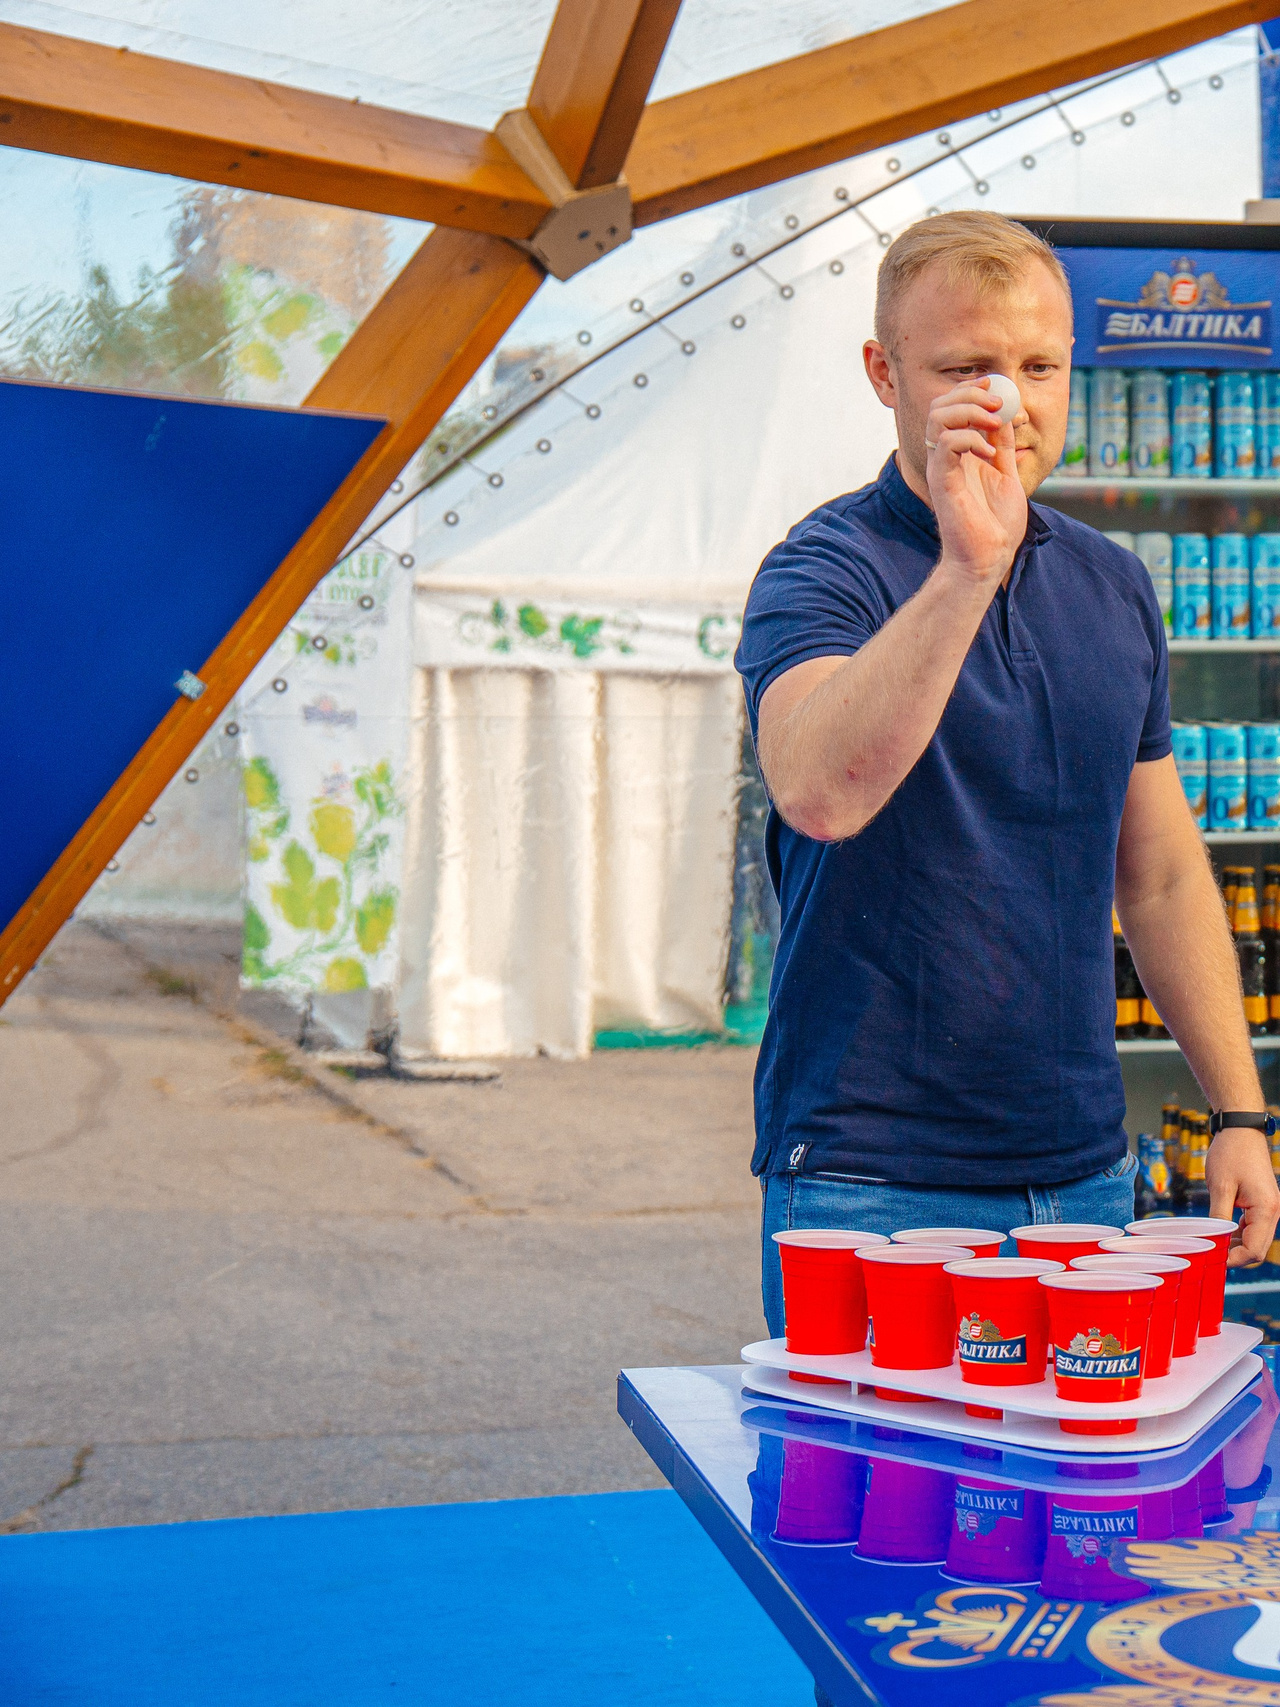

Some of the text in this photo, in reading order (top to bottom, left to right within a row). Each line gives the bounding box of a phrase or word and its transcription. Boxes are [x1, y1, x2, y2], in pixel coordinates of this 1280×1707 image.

[1130, 313, 1262, 339] БАЛТИКА
[958, 1339, 1022, 1358] БАЛТИКА
[1065, 1356, 1138, 1374] БАЛТИКА
